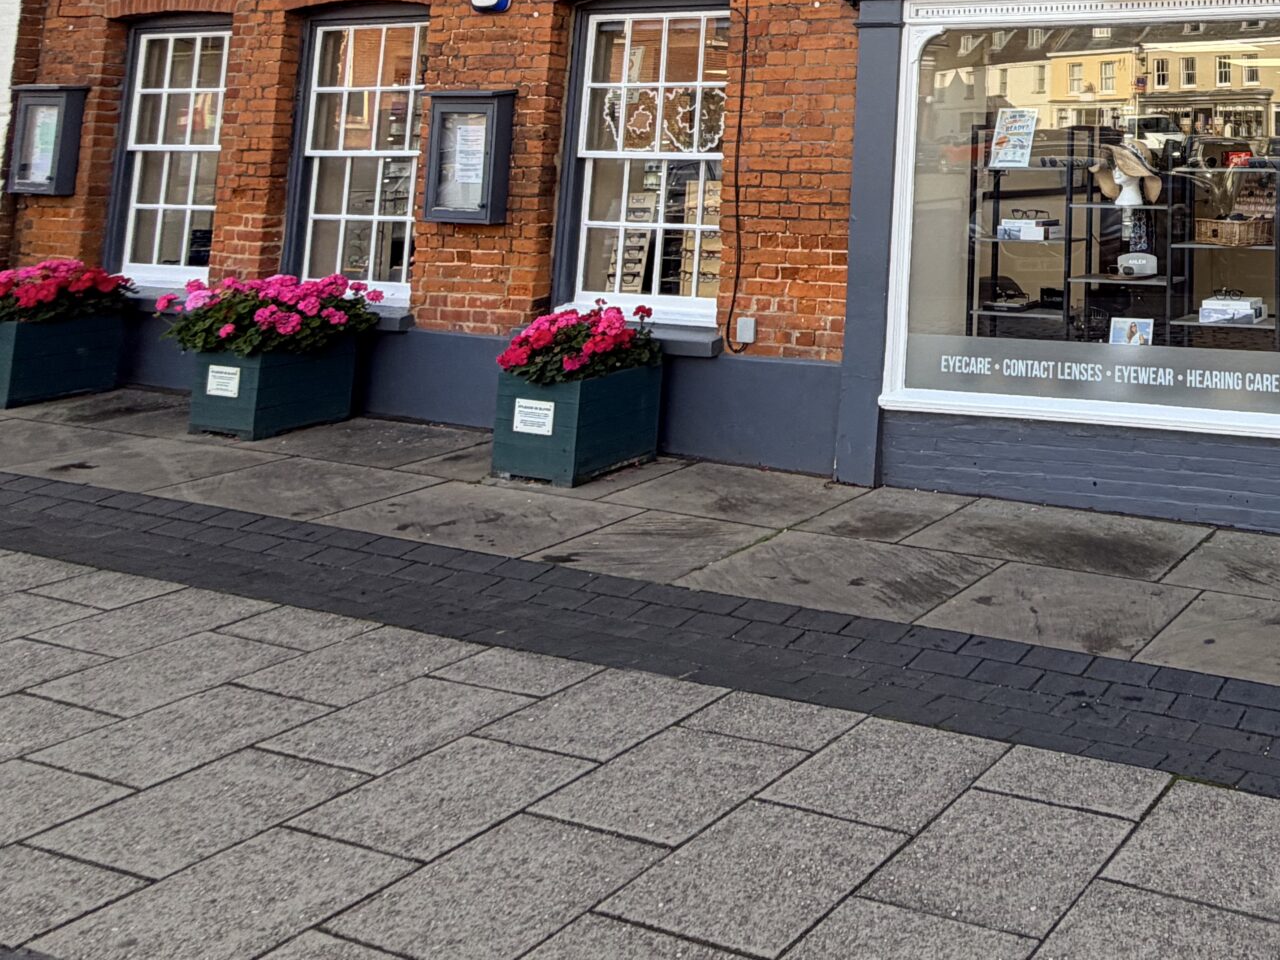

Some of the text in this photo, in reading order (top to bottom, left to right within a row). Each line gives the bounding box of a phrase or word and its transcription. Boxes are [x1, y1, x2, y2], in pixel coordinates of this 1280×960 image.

[941, 355, 1280, 393] EYECARE CONTACT LENSES EYEWEAR HEARING CARE
